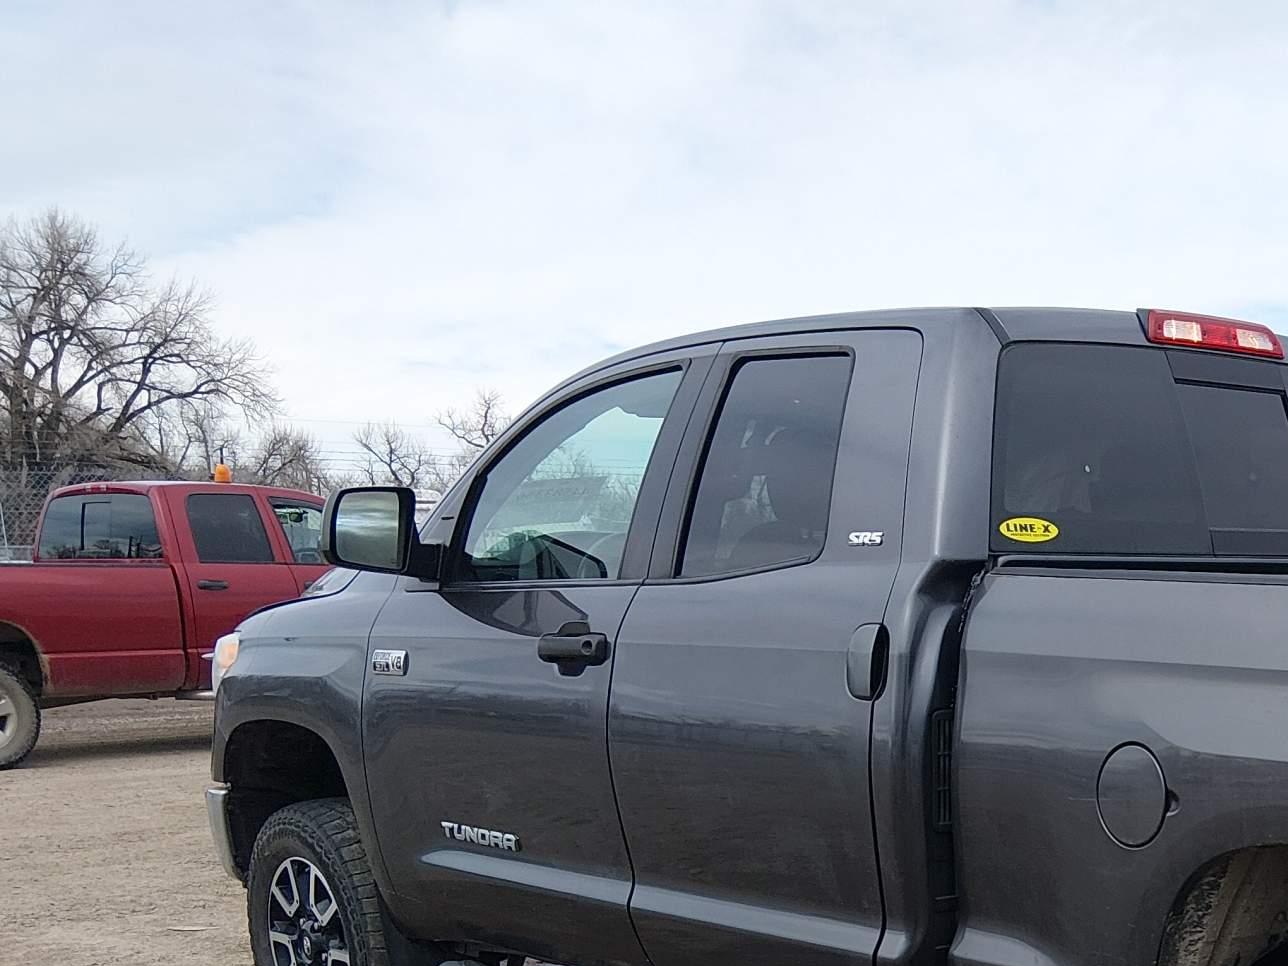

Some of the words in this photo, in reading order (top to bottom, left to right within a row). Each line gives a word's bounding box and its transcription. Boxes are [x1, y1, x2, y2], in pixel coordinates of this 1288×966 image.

[1006, 523, 1051, 533] LINE-X
[848, 531, 884, 546] SR5
[440, 821, 519, 852] TUNDRA
